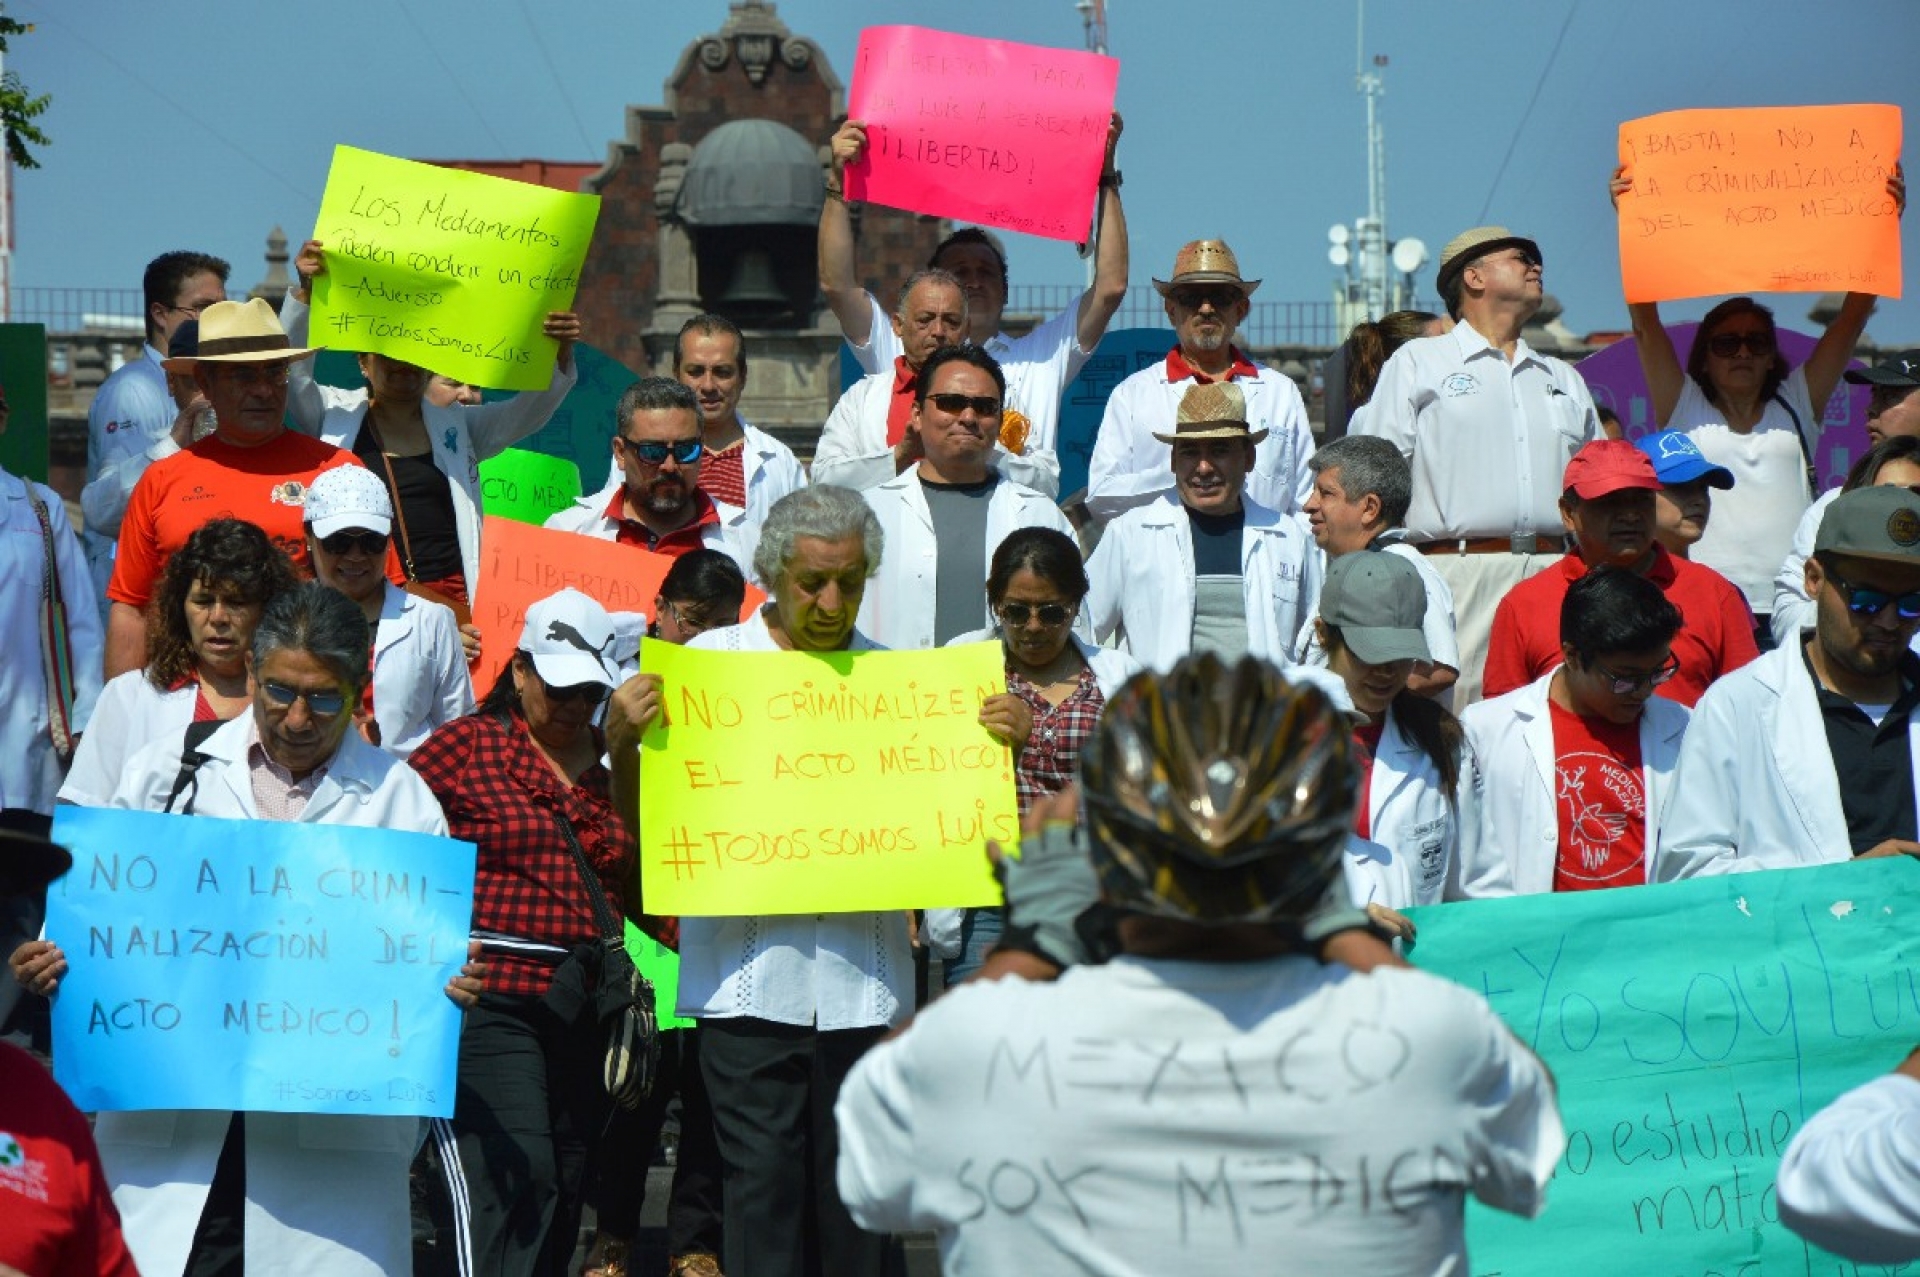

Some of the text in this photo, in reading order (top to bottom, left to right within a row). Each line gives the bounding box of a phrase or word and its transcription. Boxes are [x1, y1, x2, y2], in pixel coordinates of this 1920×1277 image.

[1777, 126, 1814, 151] NO
[1850, 128, 1865, 150] A
[1633, 177, 1662, 198] LA
[1637, 213, 1693, 238] DEL
[1725, 205, 1778, 227] ACTO
[498, 266, 522, 285] un
[482, 477, 518, 503] CTO
[497, 603, 528, 631] PA
[685, 759, 743, 790] EL
[774, 752, 856, 781] ACTO
[196, 858, 220, 895] A
[248, 865, 292, 900] LA
[374, 926, 452, 965] DEL
[88, 998, 182, 1037] ACTO
[983, 1015, 1412, 1110] MEXICO
